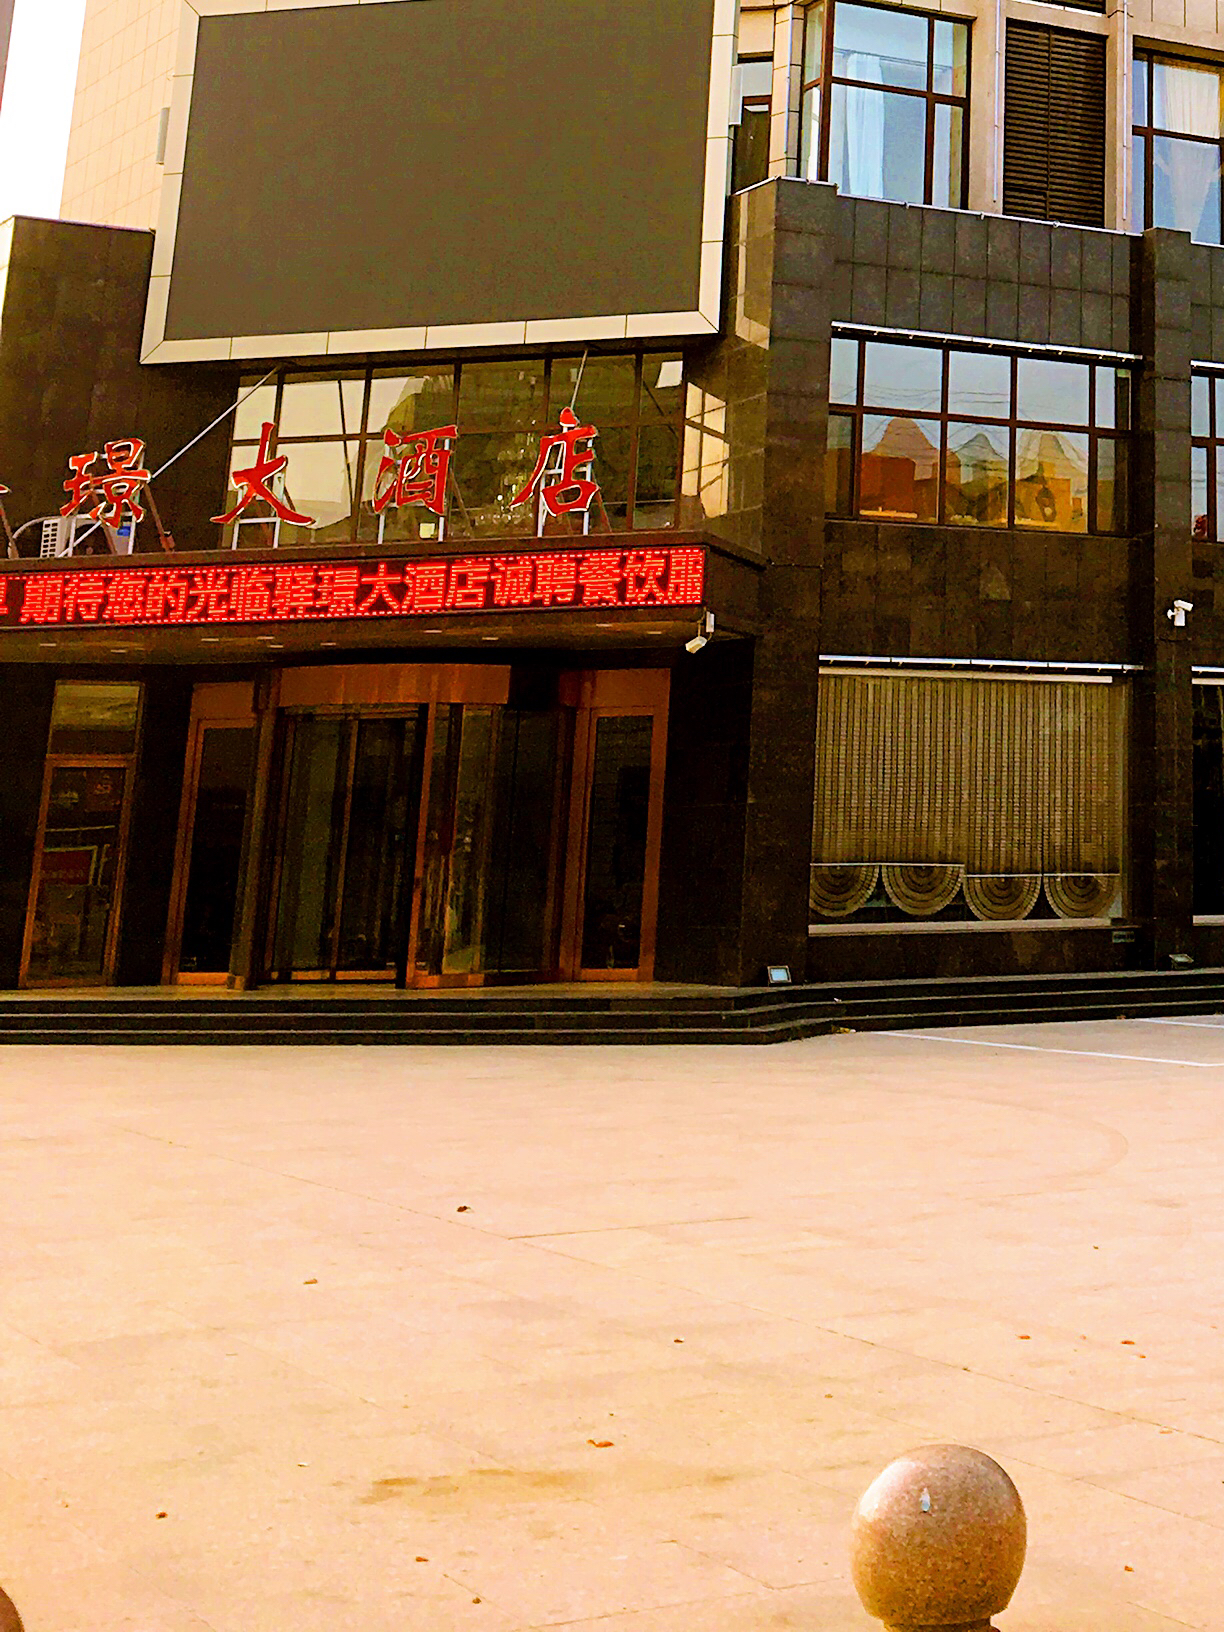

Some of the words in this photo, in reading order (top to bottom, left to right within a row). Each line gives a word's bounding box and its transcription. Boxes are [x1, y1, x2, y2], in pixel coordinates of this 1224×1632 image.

[0, 407, 599, 529] 璟大酒店
[0, 550, 703, 624] 期待您的光临驿璟大酒店诚聘餐饮服
